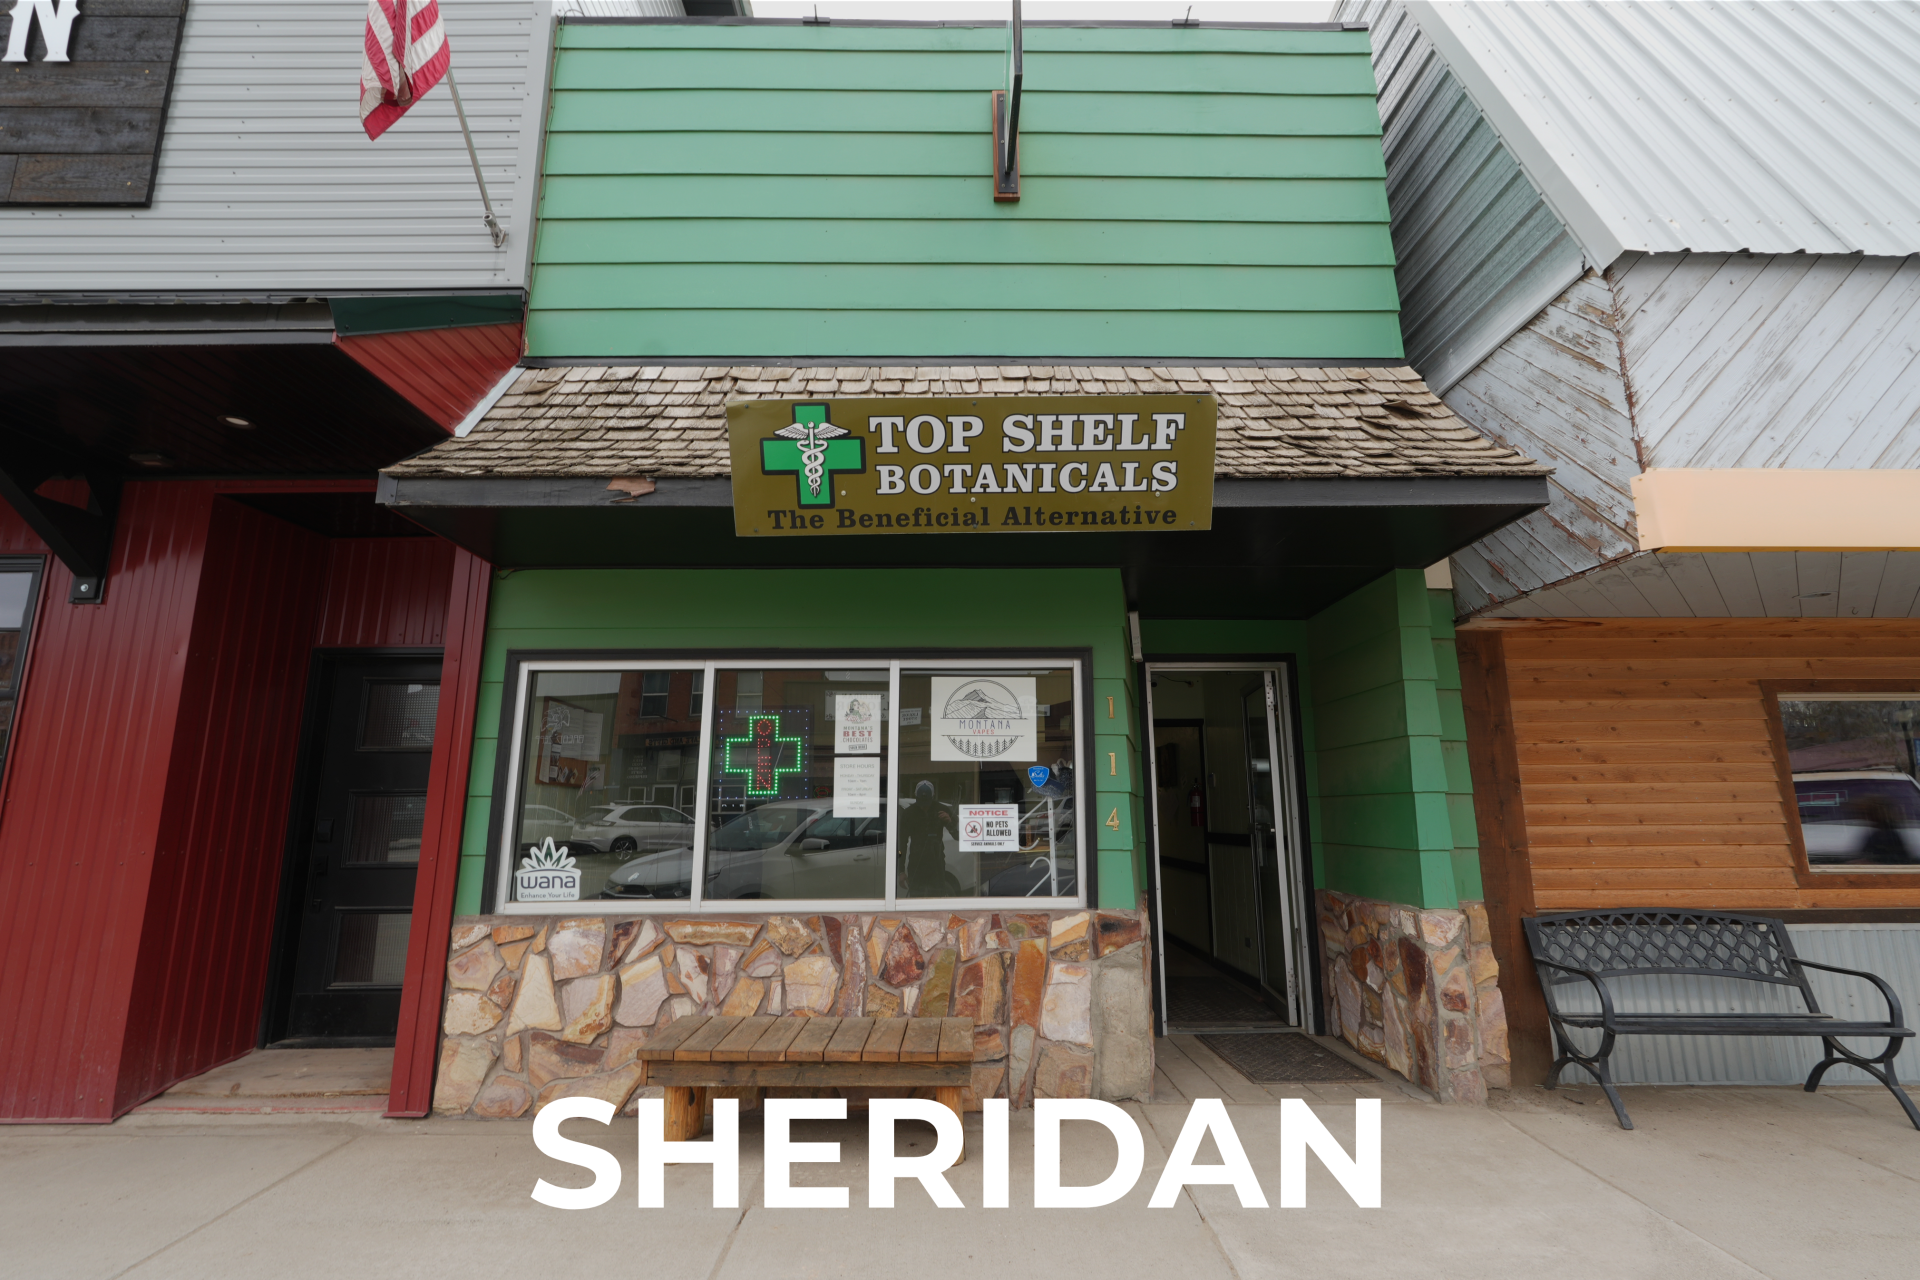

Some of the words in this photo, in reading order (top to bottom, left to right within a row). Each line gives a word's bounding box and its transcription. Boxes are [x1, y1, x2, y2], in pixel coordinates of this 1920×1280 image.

[868, 414, 984, 454] TOP
[1002, 412, 1187, 453] SHELF
[875, 460, 1179, 496] BOTANICALS
[767, 509, 825, 530] The
[836, 506, 991, 529] Beneficial
[1003, 505, 1177, 527] Alternative
[959, 719, 1011, 730] MONTANA
[757, 719, 771, 790] OPEN
[986, 829, 1012, 837] ALLOWED
[995, 820, 1009, 828] PETS
[520, 875, 576, 889] wana
